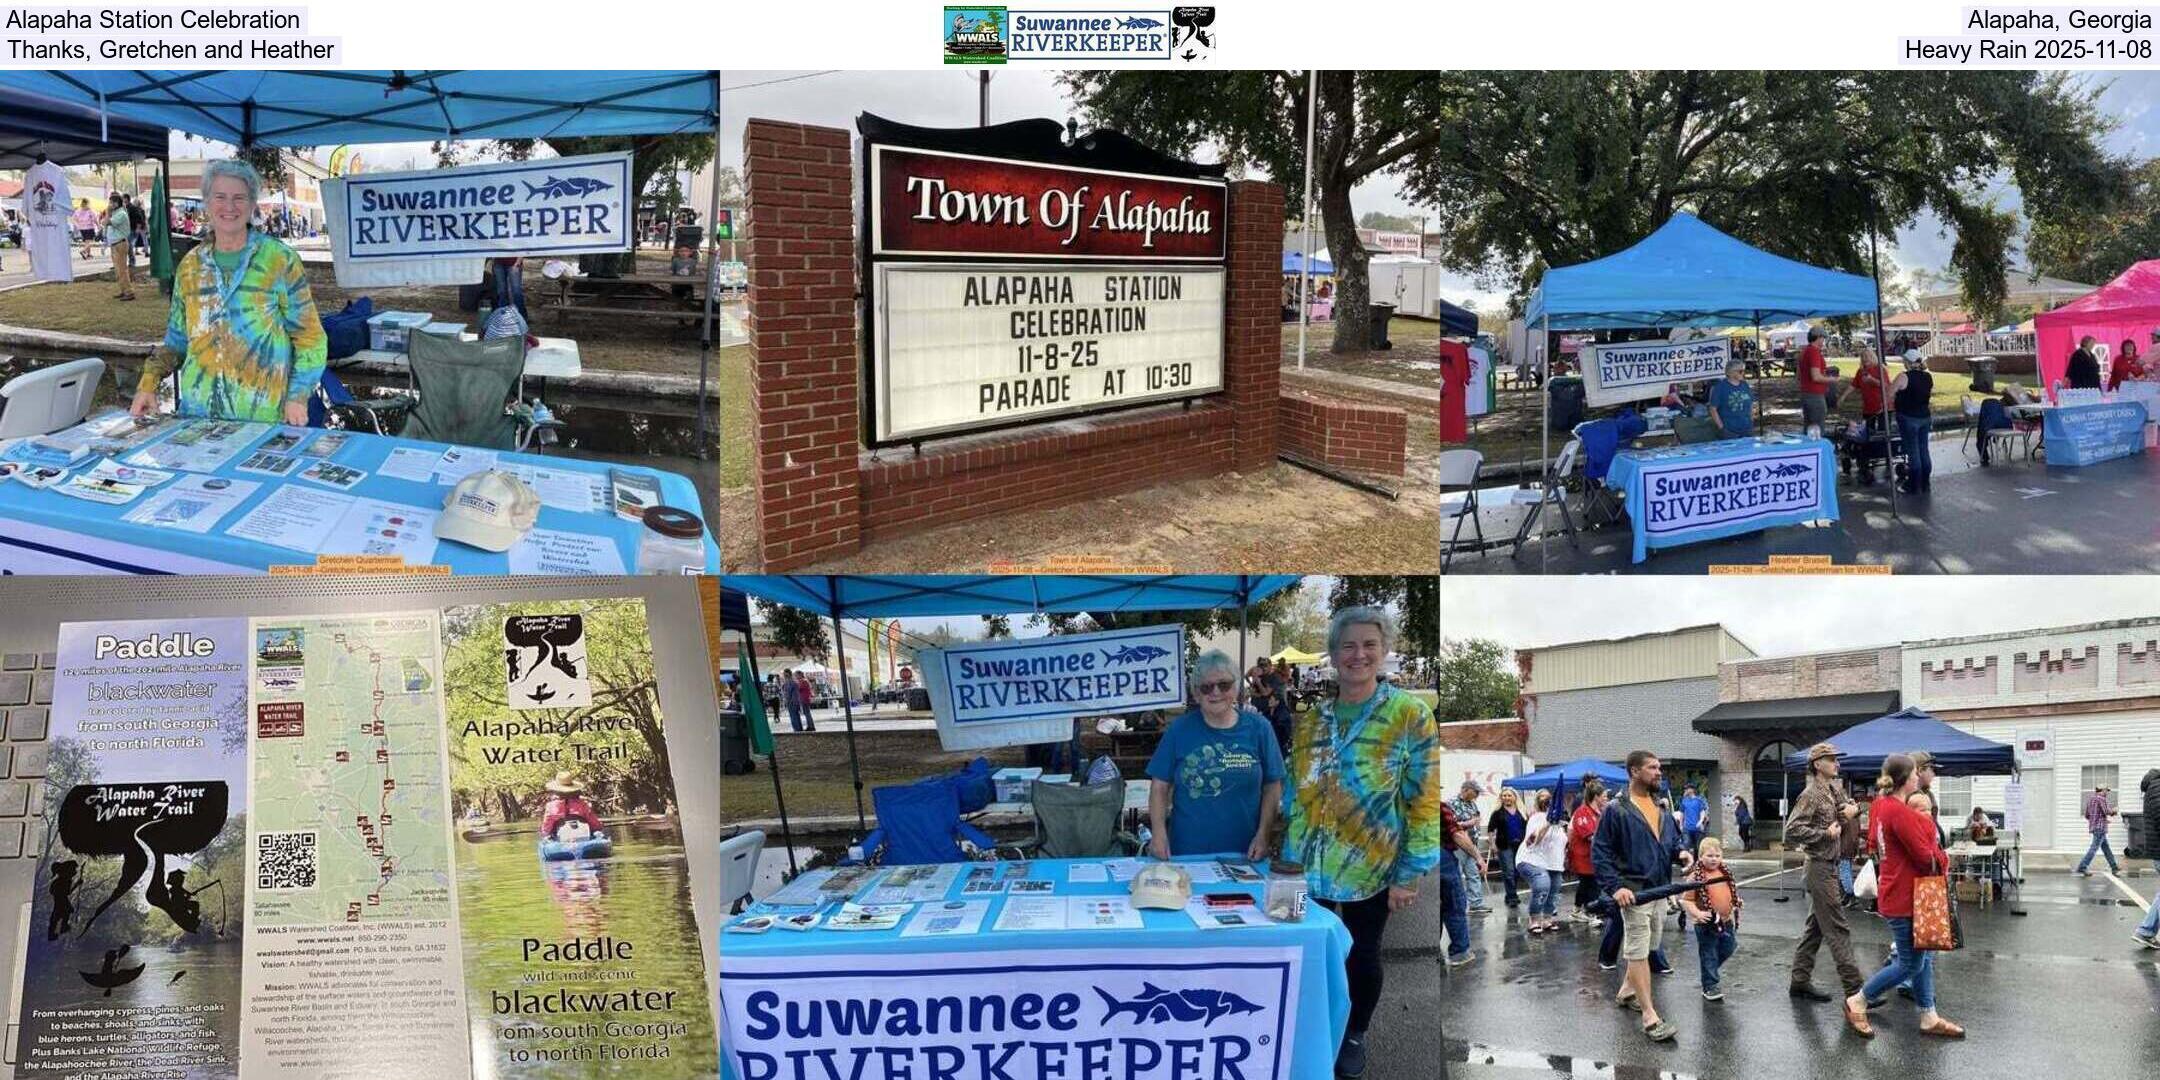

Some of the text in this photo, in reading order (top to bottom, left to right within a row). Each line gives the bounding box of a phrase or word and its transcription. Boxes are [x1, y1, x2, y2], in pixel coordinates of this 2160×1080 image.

[361, 183, 516, 212] Suwannee
[906, 176, 1212, 247] Town Of Alapaha
[964, 275, 1182, 307] ALAPAHA STATION
[1010, 306, 1146, 339] CELEBRATION
[1018, 340, 1099, 373] 11-8-25
[1604, 348, 1686, 364] Suwannee
[979, 362, 1192, 413] PARADE AT 10:30
[1655, 467, 1761, 497] Suwannee
[95, 632, 215, 660] Paddle
[216, 663, 242, 672] River
[960, 651, 1096, 680] Suwannee
[88, 680, 218, 701] blackwater
[77, 717, 219, 733] from south Georgia
[462, 714, 643, 741] Alapaha River
[89, 735, 205, 750] to north Florida
[482, 742, 629, 765] Water Trail
[85, 785, 206, 805] Alapaha River
[95, 801, 194, 822] Water Trail
[257, 926, 288, 934] WWALS
[522, 936, 634, 962] Paddle
[522, 967, 637, 983] wild and scenic
[32, 1010, 56, 1018] From
[57, 1008, 114, 1018] overhanging
[183, 1004, 201, 1013] and
[203, 1003, 225, 1012] oaks
[490, 988, 677, 1016] blackwater
[137, 1018, 157, 1028] and
[184, 1016, 205, 1026] with
[745, 989, 1082, 1040] Suwannee
[38, 1035, 59, 1044] blue
[180, 1030, 197, 1038] and
[541, 1022, 599, 1040] south
[604, 1020, 688, 1041] Georgia
[31, 1048, 51, 1057] Plus
[53, 1047, 80, 1056] Banks
[83, 1046, 105, 1055] Lake
[107, 1044, 146, 1054] National
[148, 1043, 184, 1053] Wildlife
[509, 1043, 671, 1063] to north Florida
[24, 1061, 39, 1069] the
[41, 1059, 107, 1070] Alapahoochee
[137, 1058, 153, 1067] the
[155, 1056, 179, 1066] Dead
[180, 1056, 204, 1065] River
[84, 1072, 99, 1080] the
[100, 1072, 140, 1080] Alapaha
[141, 1070, 166, 1080] River
[167, 1069, 188, 1080] Rise
